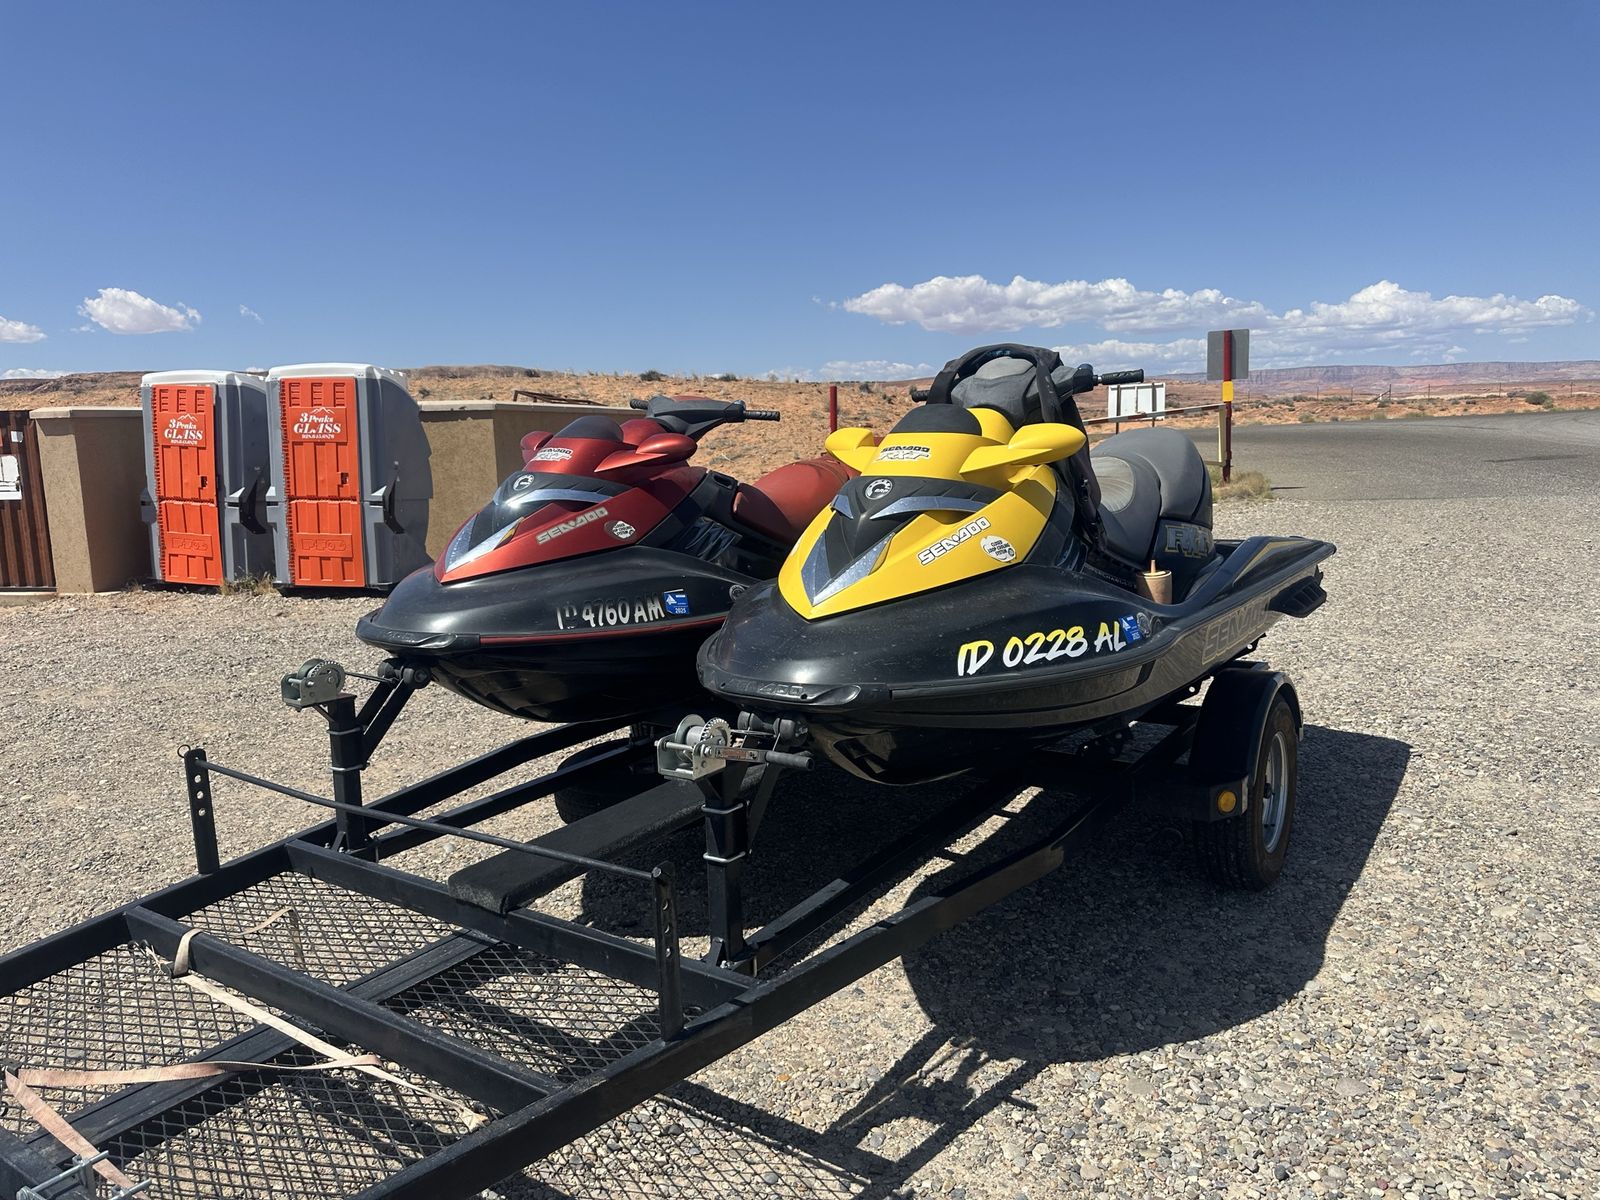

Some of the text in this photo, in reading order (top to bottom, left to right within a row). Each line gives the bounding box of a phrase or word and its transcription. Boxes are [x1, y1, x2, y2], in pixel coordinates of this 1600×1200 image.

[169, 419, 176, 428] 3
[300, 413, 334, 423] 3 Peaks
[164, 428, 203, 440] GLASS
[294, 423, 341, 434] GLASS
[582, 598, 630, 628] 4760
[634, 595, 665, 624] AM
[957, 621, 1127, 676] ID 0228 AL
